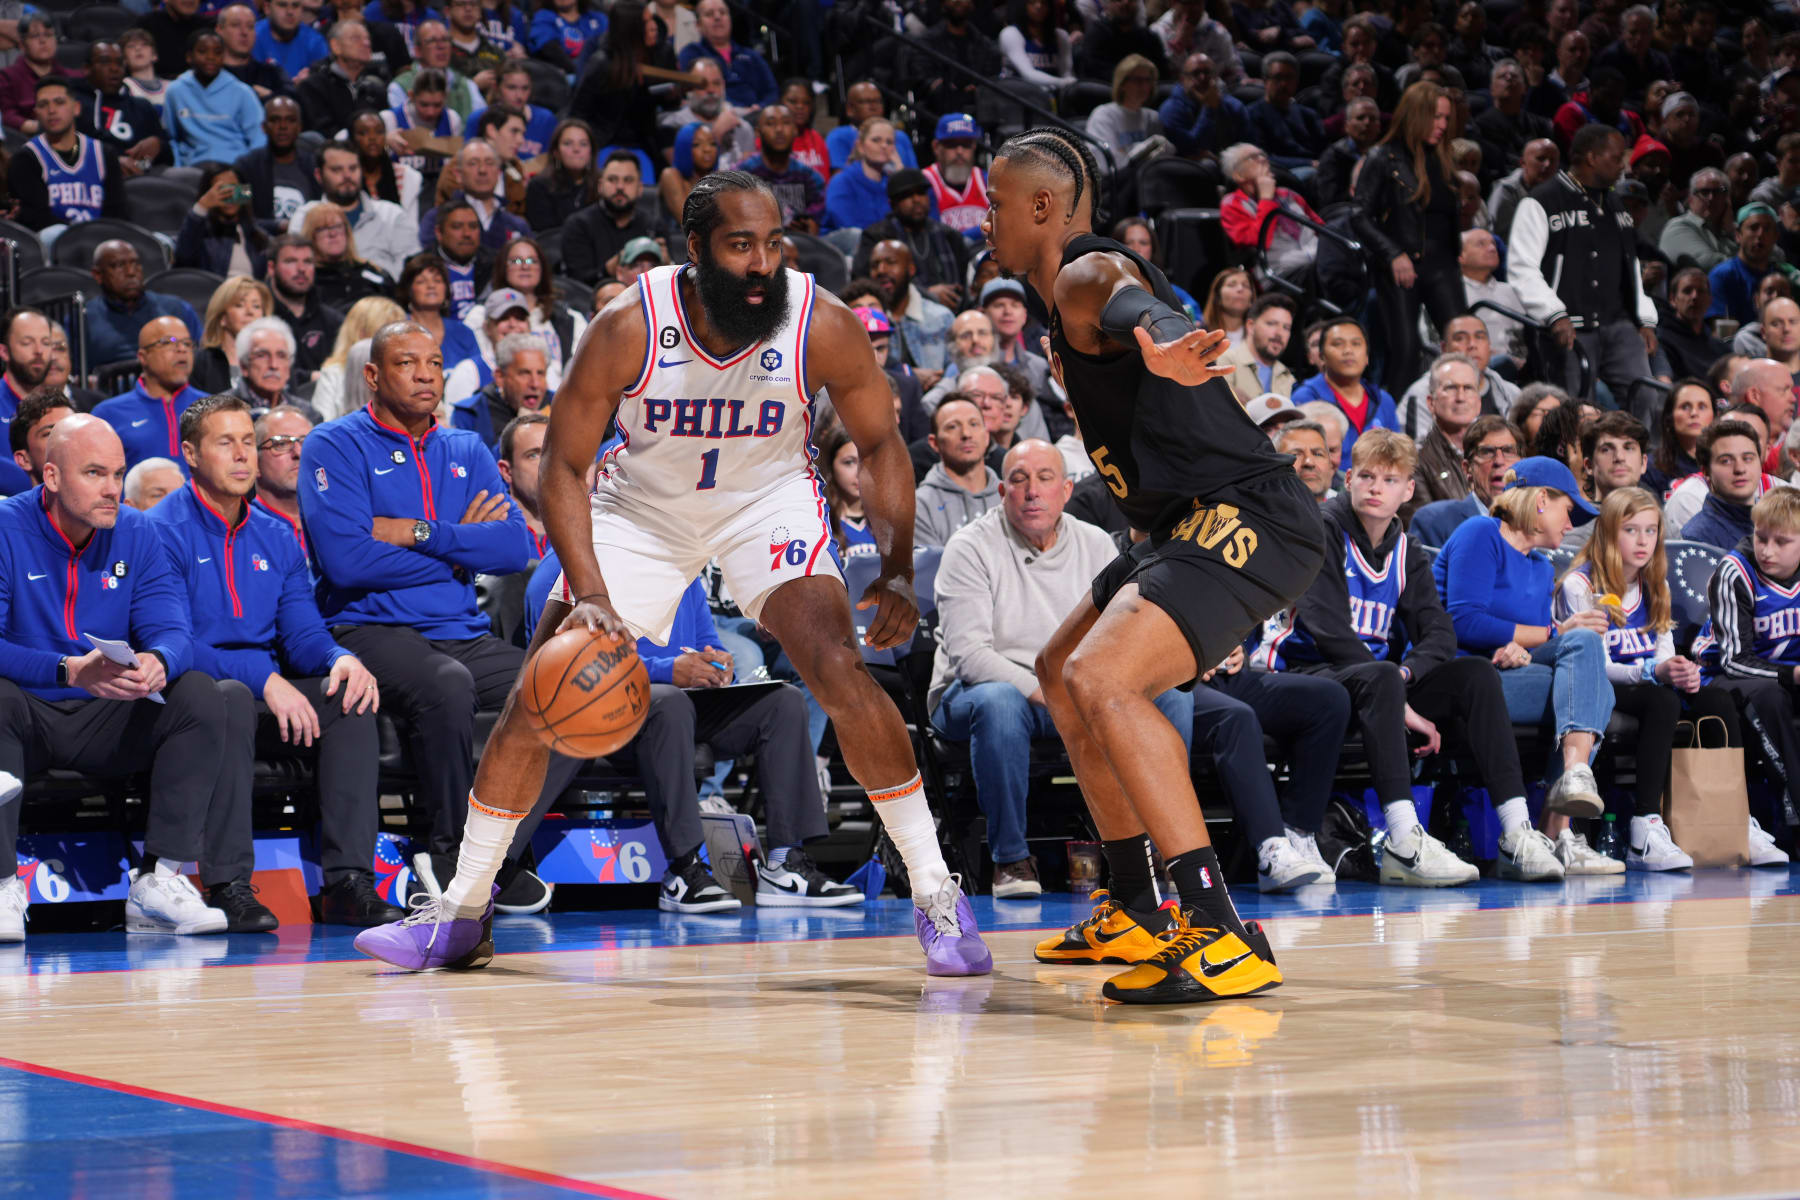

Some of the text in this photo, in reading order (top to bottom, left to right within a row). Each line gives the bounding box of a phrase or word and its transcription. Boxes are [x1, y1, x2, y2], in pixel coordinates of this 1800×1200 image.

[101, 106, 133, 140] 76
[1549, 210, 1591, 232] GIVE
[663, 329, 676, 347] 6
[749, 374, 791, 383] crypto.com
[396, 450, 406, 463] 6
[451, 466, 467, 478] 76
[696, 448, 720, 490] 1
[1090, 445, 1129, 499] 5
[770, 539, 807, 572] 76
[115, 562, 126, 577] 6
[252, 559, 269, 571] 76
[101, 576, 118, 590] 76
[591, 842, 651, 883] 76
